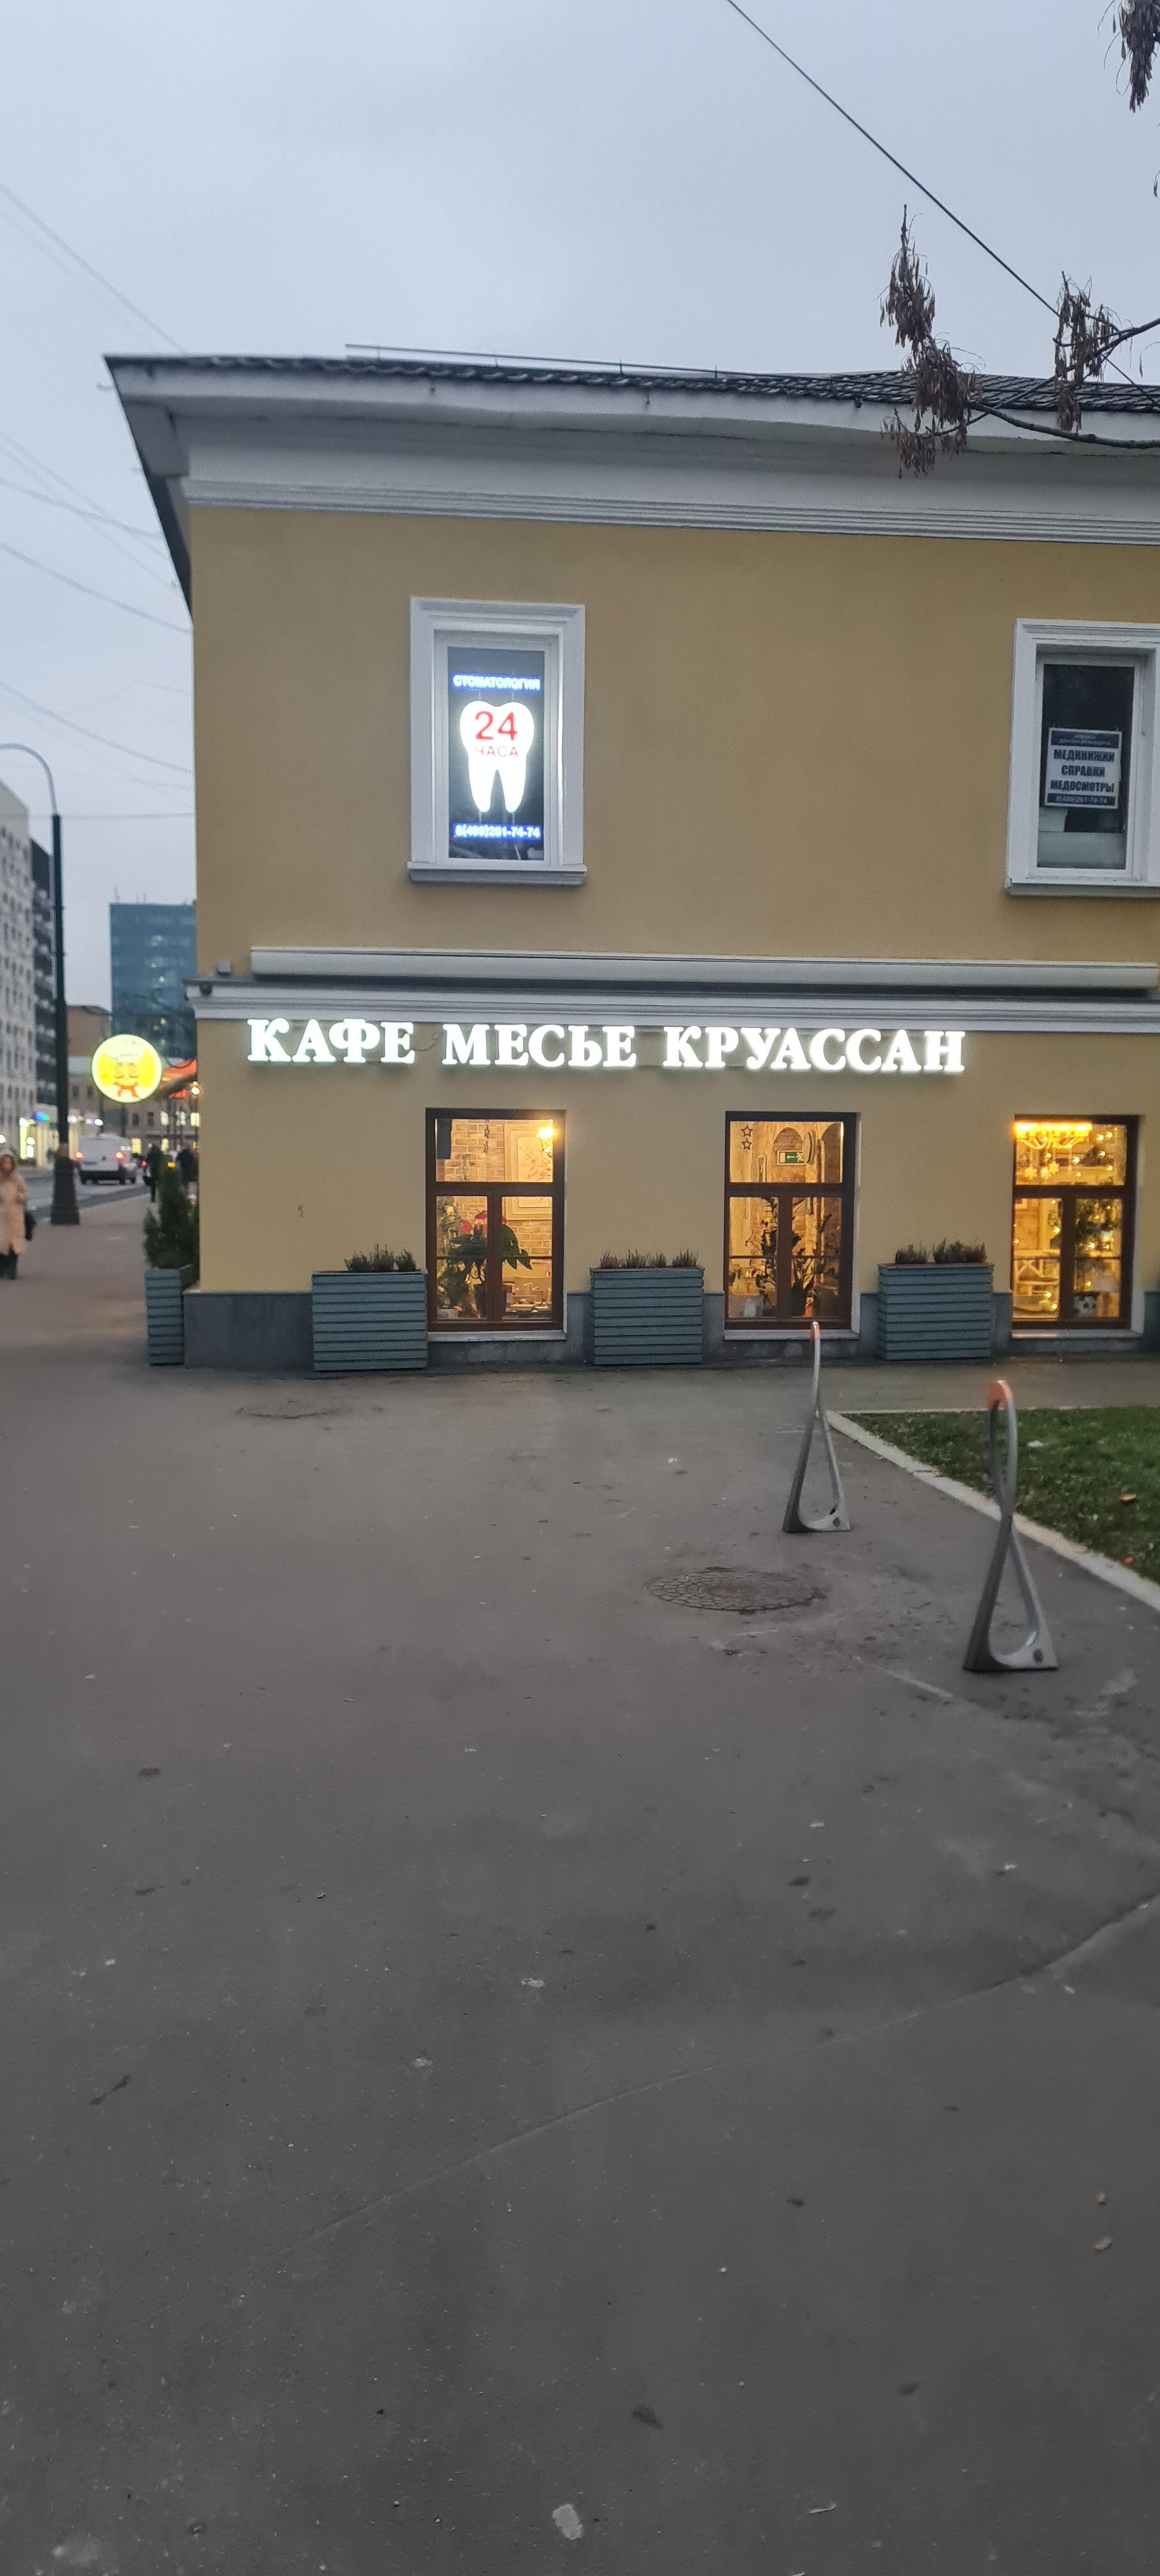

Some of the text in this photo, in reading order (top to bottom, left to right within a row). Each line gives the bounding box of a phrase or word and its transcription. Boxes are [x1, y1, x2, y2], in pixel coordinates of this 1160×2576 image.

[453, 675, 540, 691] СТОМАТОЛОГИЯ
[475, 711, 518, 740] 24
[475, 746, 519, 757] ЧАСА
[1053, 749, 1115, 762] МЕДКНИЖКИ
[1061, 765, 1105, 777] СПРАВКИ
[1050, 779, 1115, 793] МЕДОСМОТРЫ
[247, 1018, 965, 1072] КАФЕ МЕСЬЕ КРУАССАН
